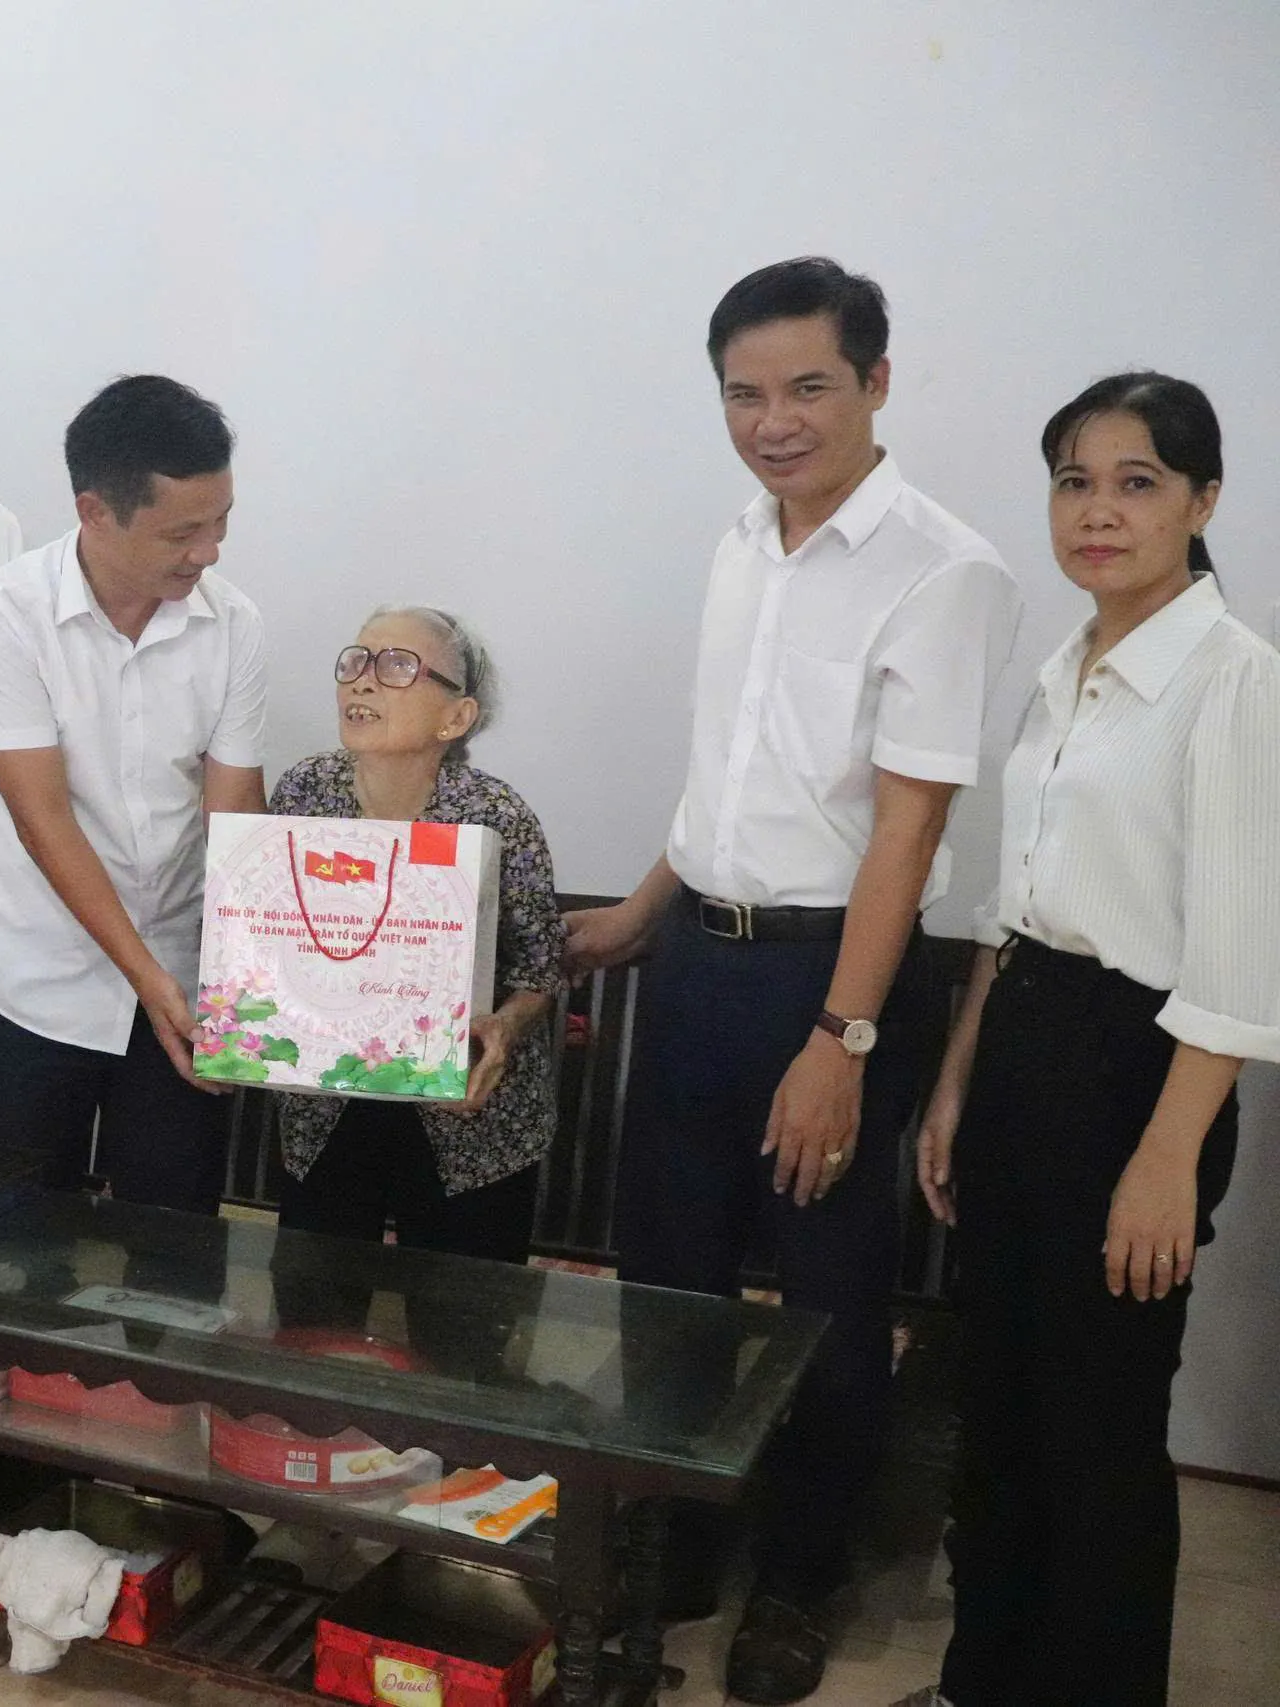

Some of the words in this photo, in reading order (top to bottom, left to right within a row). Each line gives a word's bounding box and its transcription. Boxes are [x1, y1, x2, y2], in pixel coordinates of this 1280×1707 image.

[217, 906, 240, 917] TỈNH
[313, 913, 340, 924] NHÂN
[343, 914, 363, 925] DÂN
[386, 918, 407, 928] BAN
[410, 919, 439, 930] NHÂN
[264, 926, 284, 936] BAN
[310, 929, 335, 941] RẬN
[351, 931, 377, 942] QUỐ
[380, 933, 402, 946] VIỆT
[404, 935, 427, 945] NAM
[381, 1672, 435, 1694] Daniel
